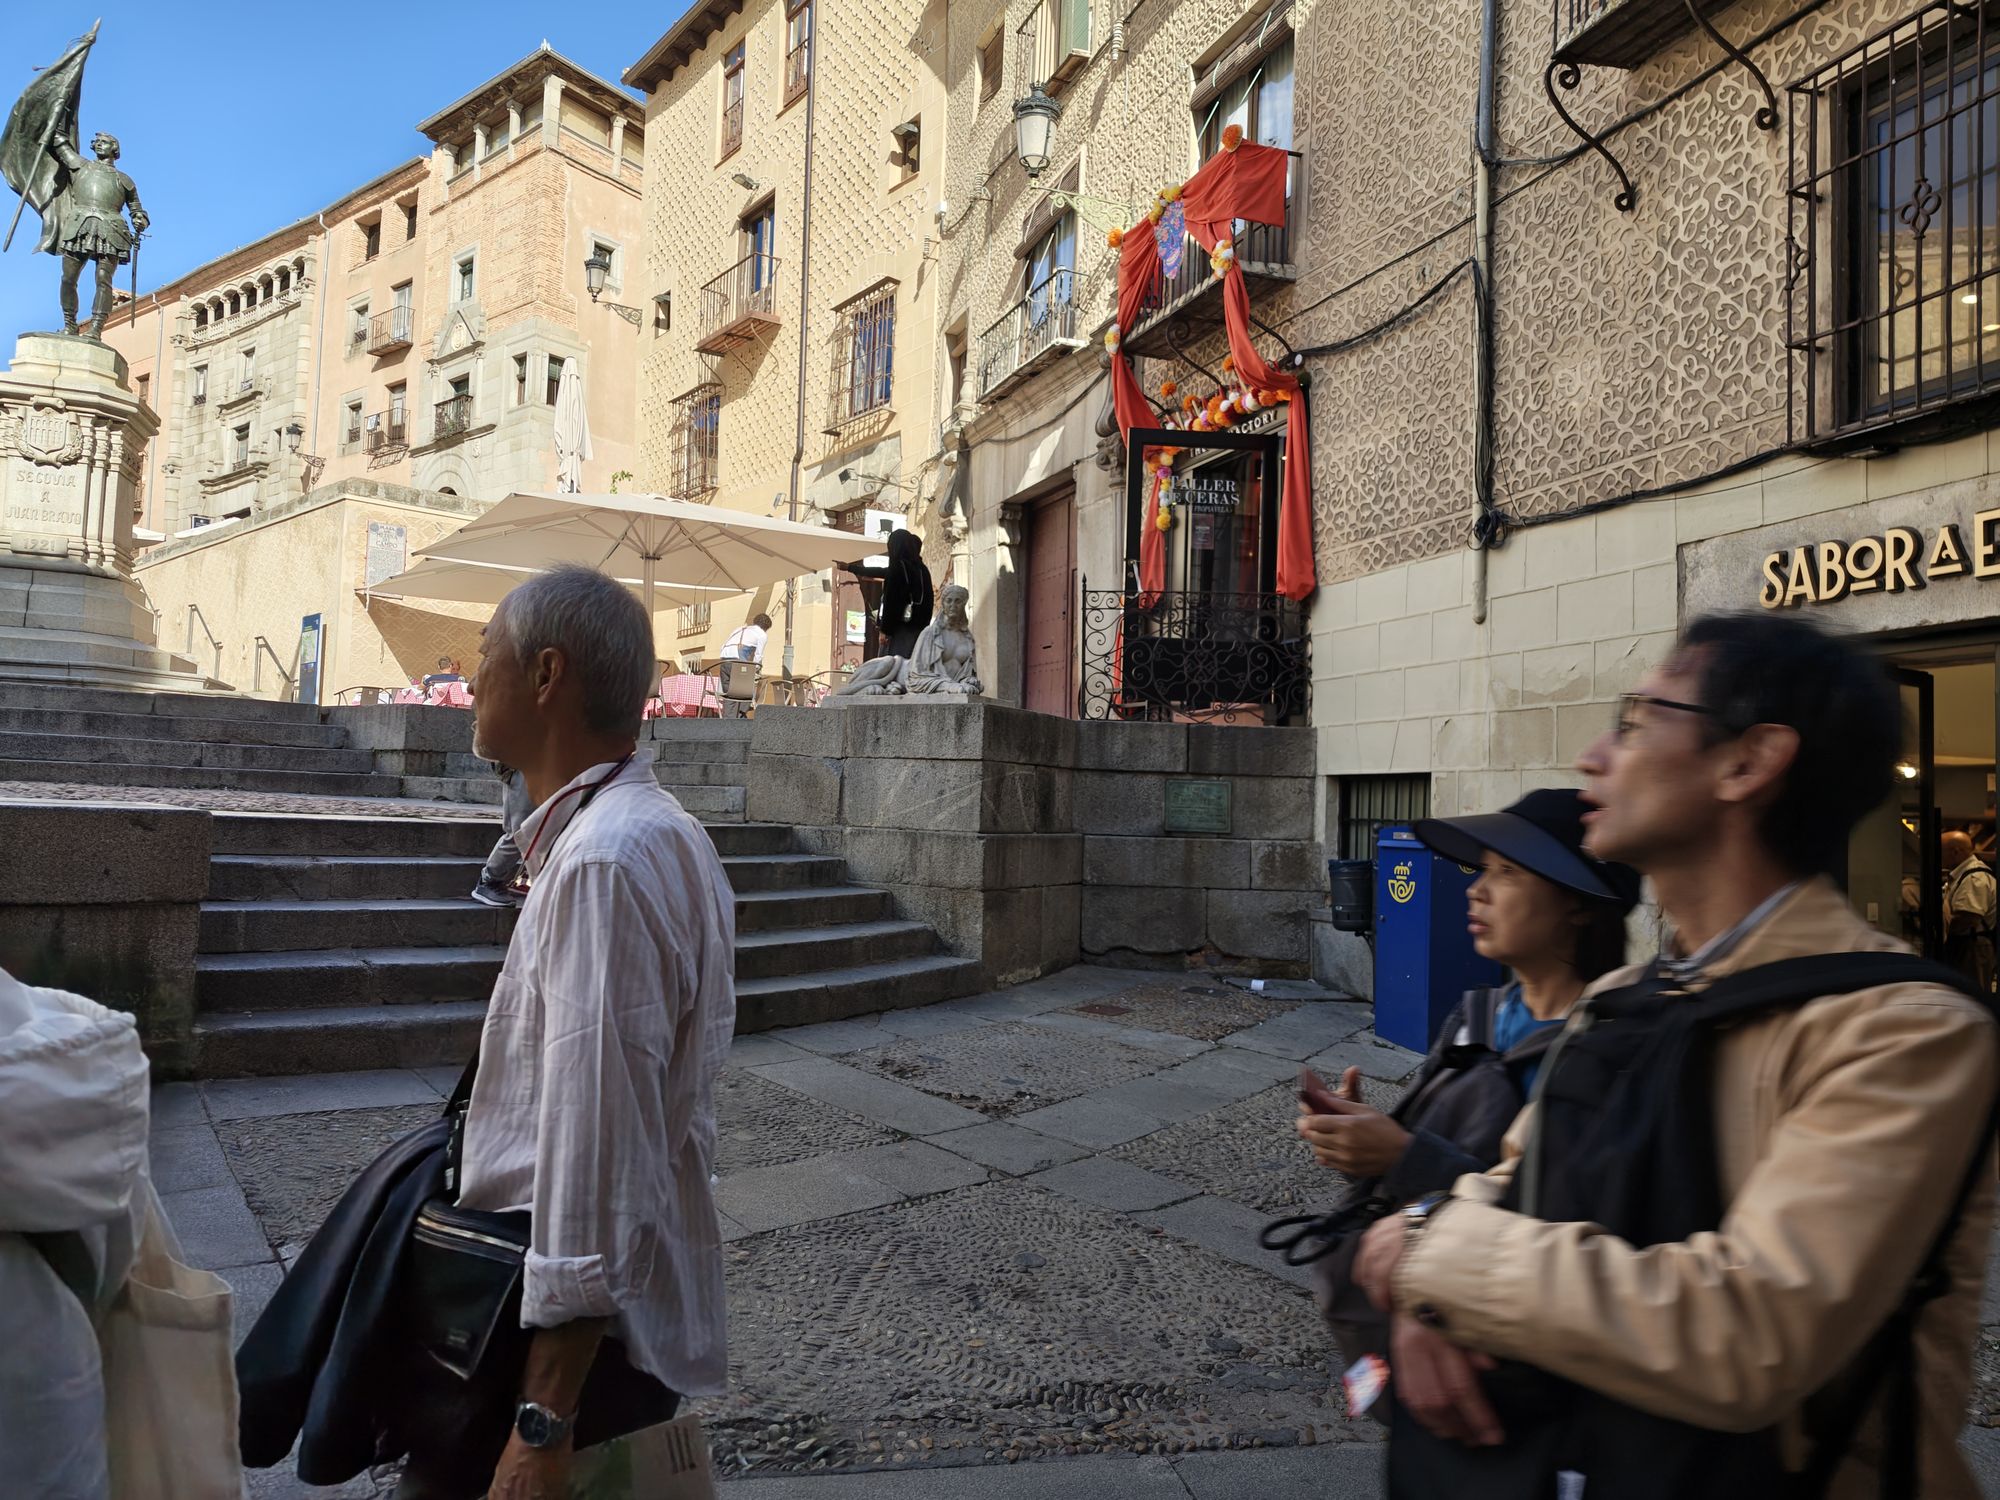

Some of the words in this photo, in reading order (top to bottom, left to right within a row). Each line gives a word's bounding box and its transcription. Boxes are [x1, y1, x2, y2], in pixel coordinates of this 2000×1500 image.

[1169, 475, 1236, 492] TALLER
[1185, 490, 1240, 505] CERAS
[1760, 526, 1922, 610] SABOR
[1927, 524, 1970, 579] A
